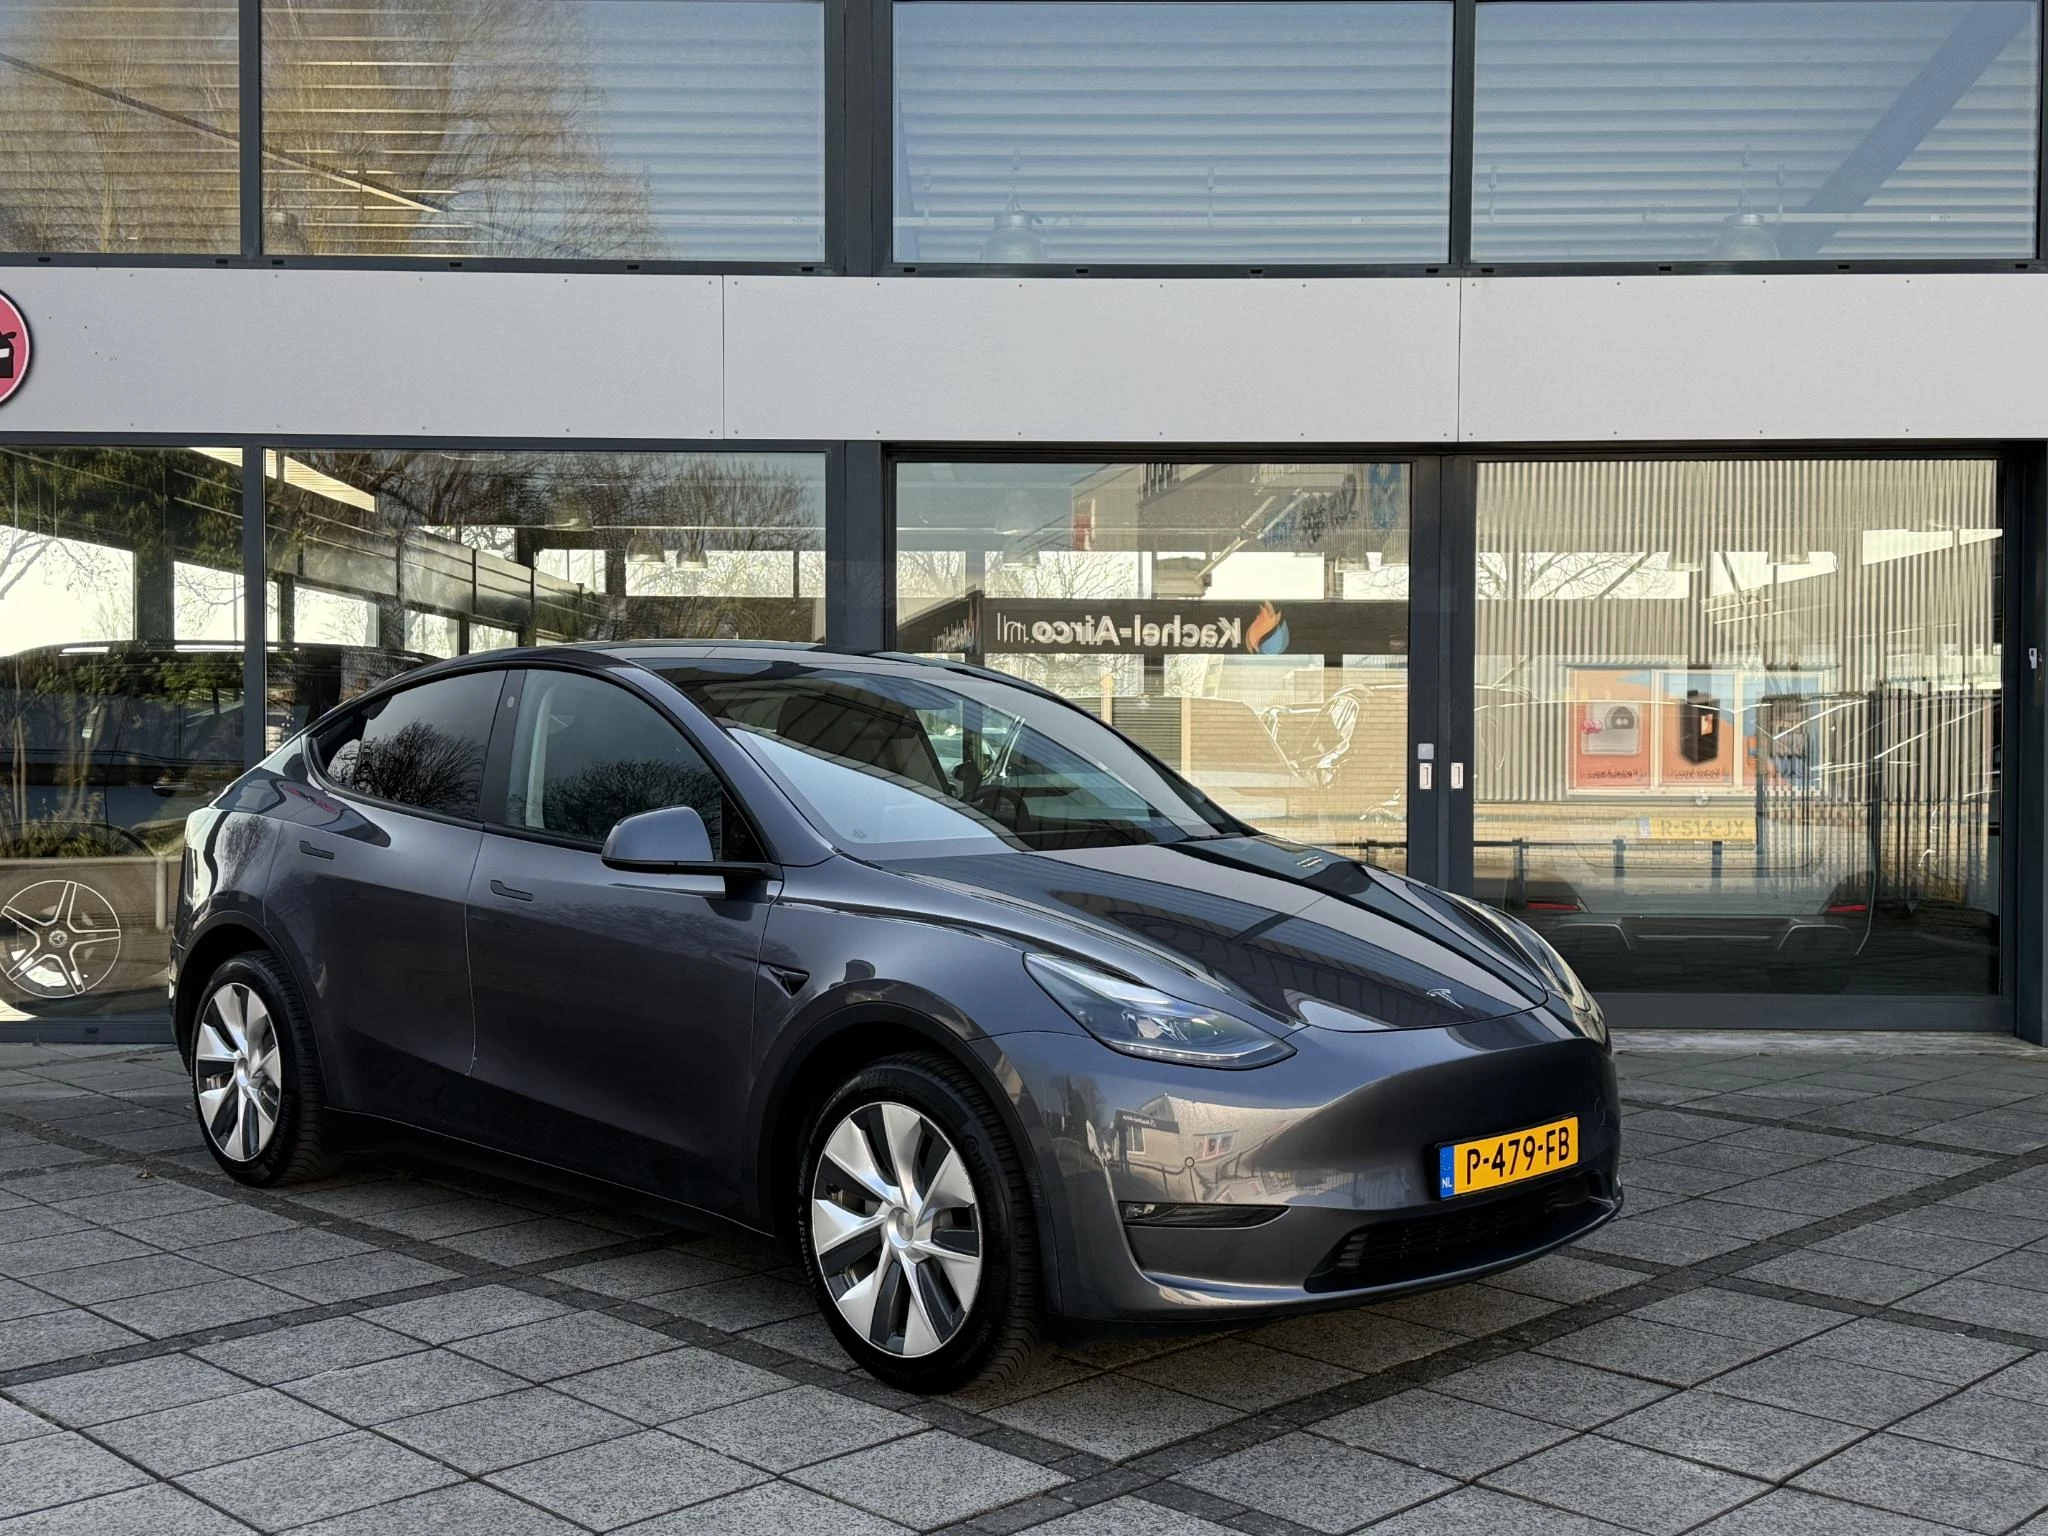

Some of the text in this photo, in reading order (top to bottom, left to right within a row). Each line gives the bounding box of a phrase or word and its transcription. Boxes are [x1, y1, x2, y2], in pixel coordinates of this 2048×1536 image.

[1661, 819, 1745, 837] R-514-JX
[1442, 1126, 1569, 1189] NL P-479-FB
